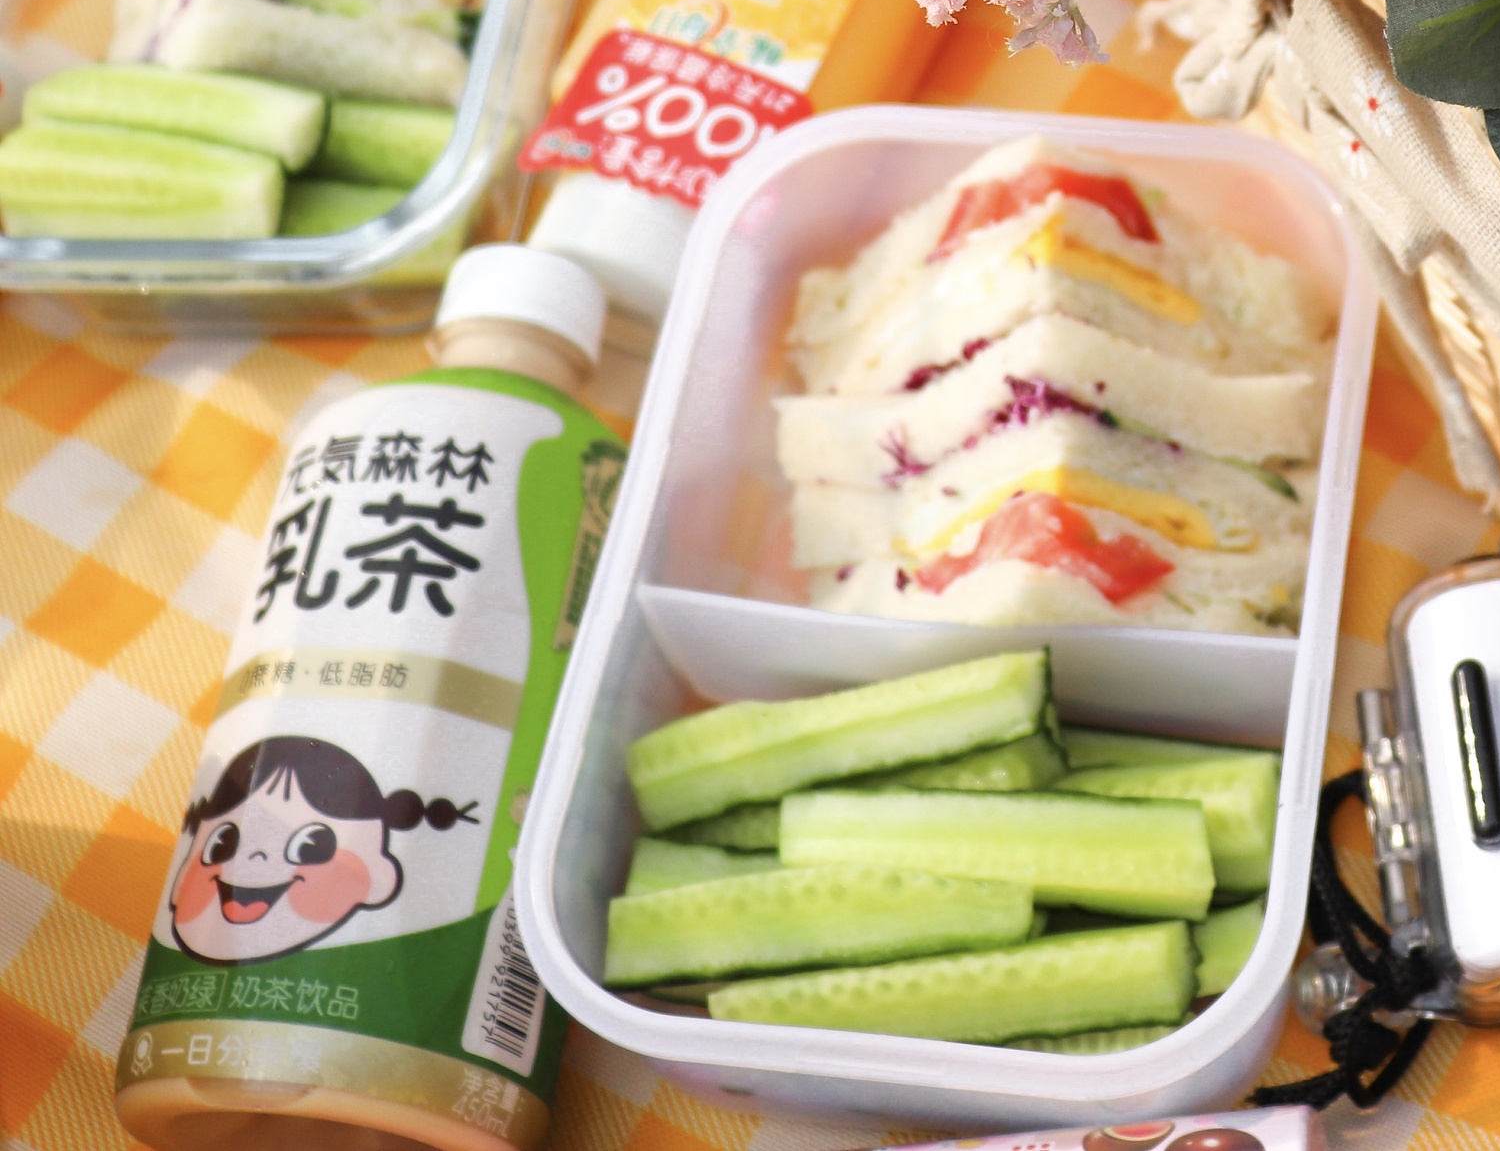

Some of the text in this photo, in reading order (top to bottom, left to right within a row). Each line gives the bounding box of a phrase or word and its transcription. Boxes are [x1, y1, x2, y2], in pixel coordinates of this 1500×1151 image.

[253, 492, 485, 624] 乳茶
[228, 975, 360, 1020] 奶茶饮品
